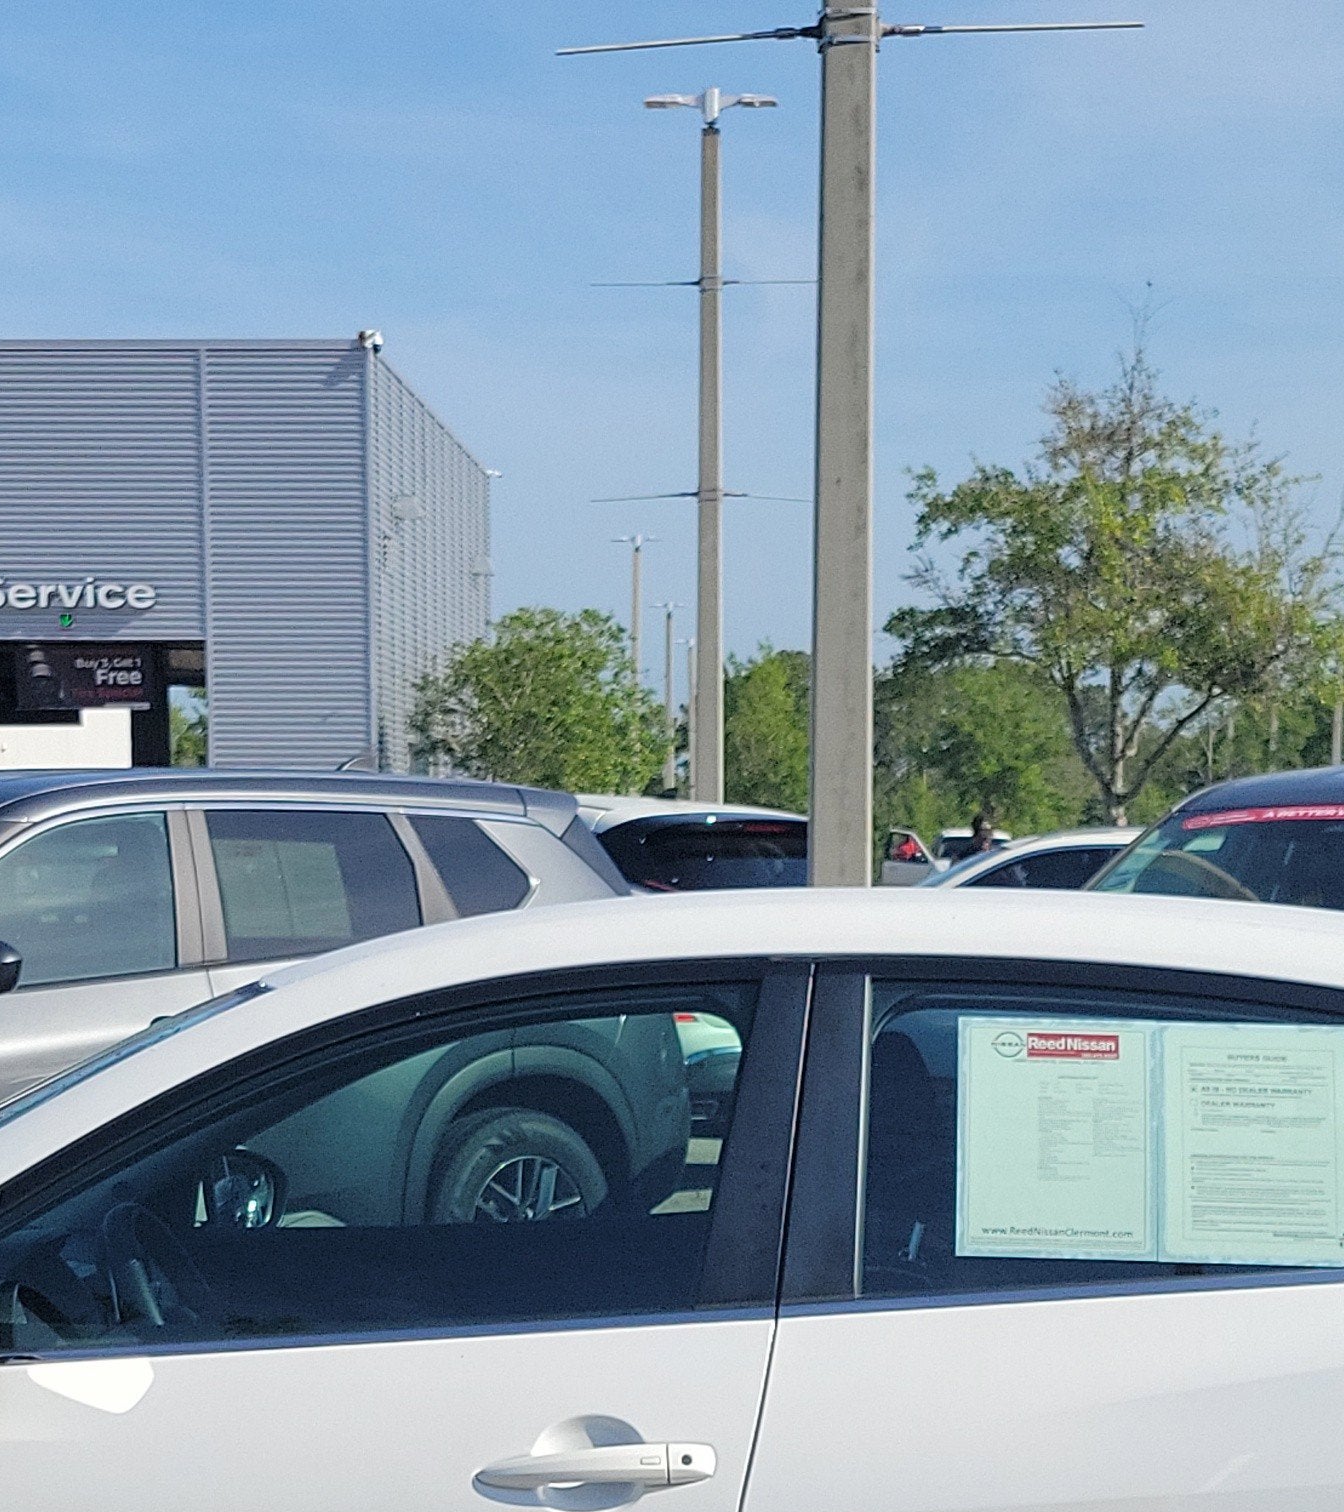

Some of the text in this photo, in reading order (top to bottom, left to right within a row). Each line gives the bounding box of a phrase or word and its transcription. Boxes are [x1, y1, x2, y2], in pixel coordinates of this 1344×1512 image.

[95, 669, 143, 685] Free
[1028, 1037, 1116, 1051] Reed Nissan
[981, 1226, 1134, 1238] www.ReedNissanClermont.com
